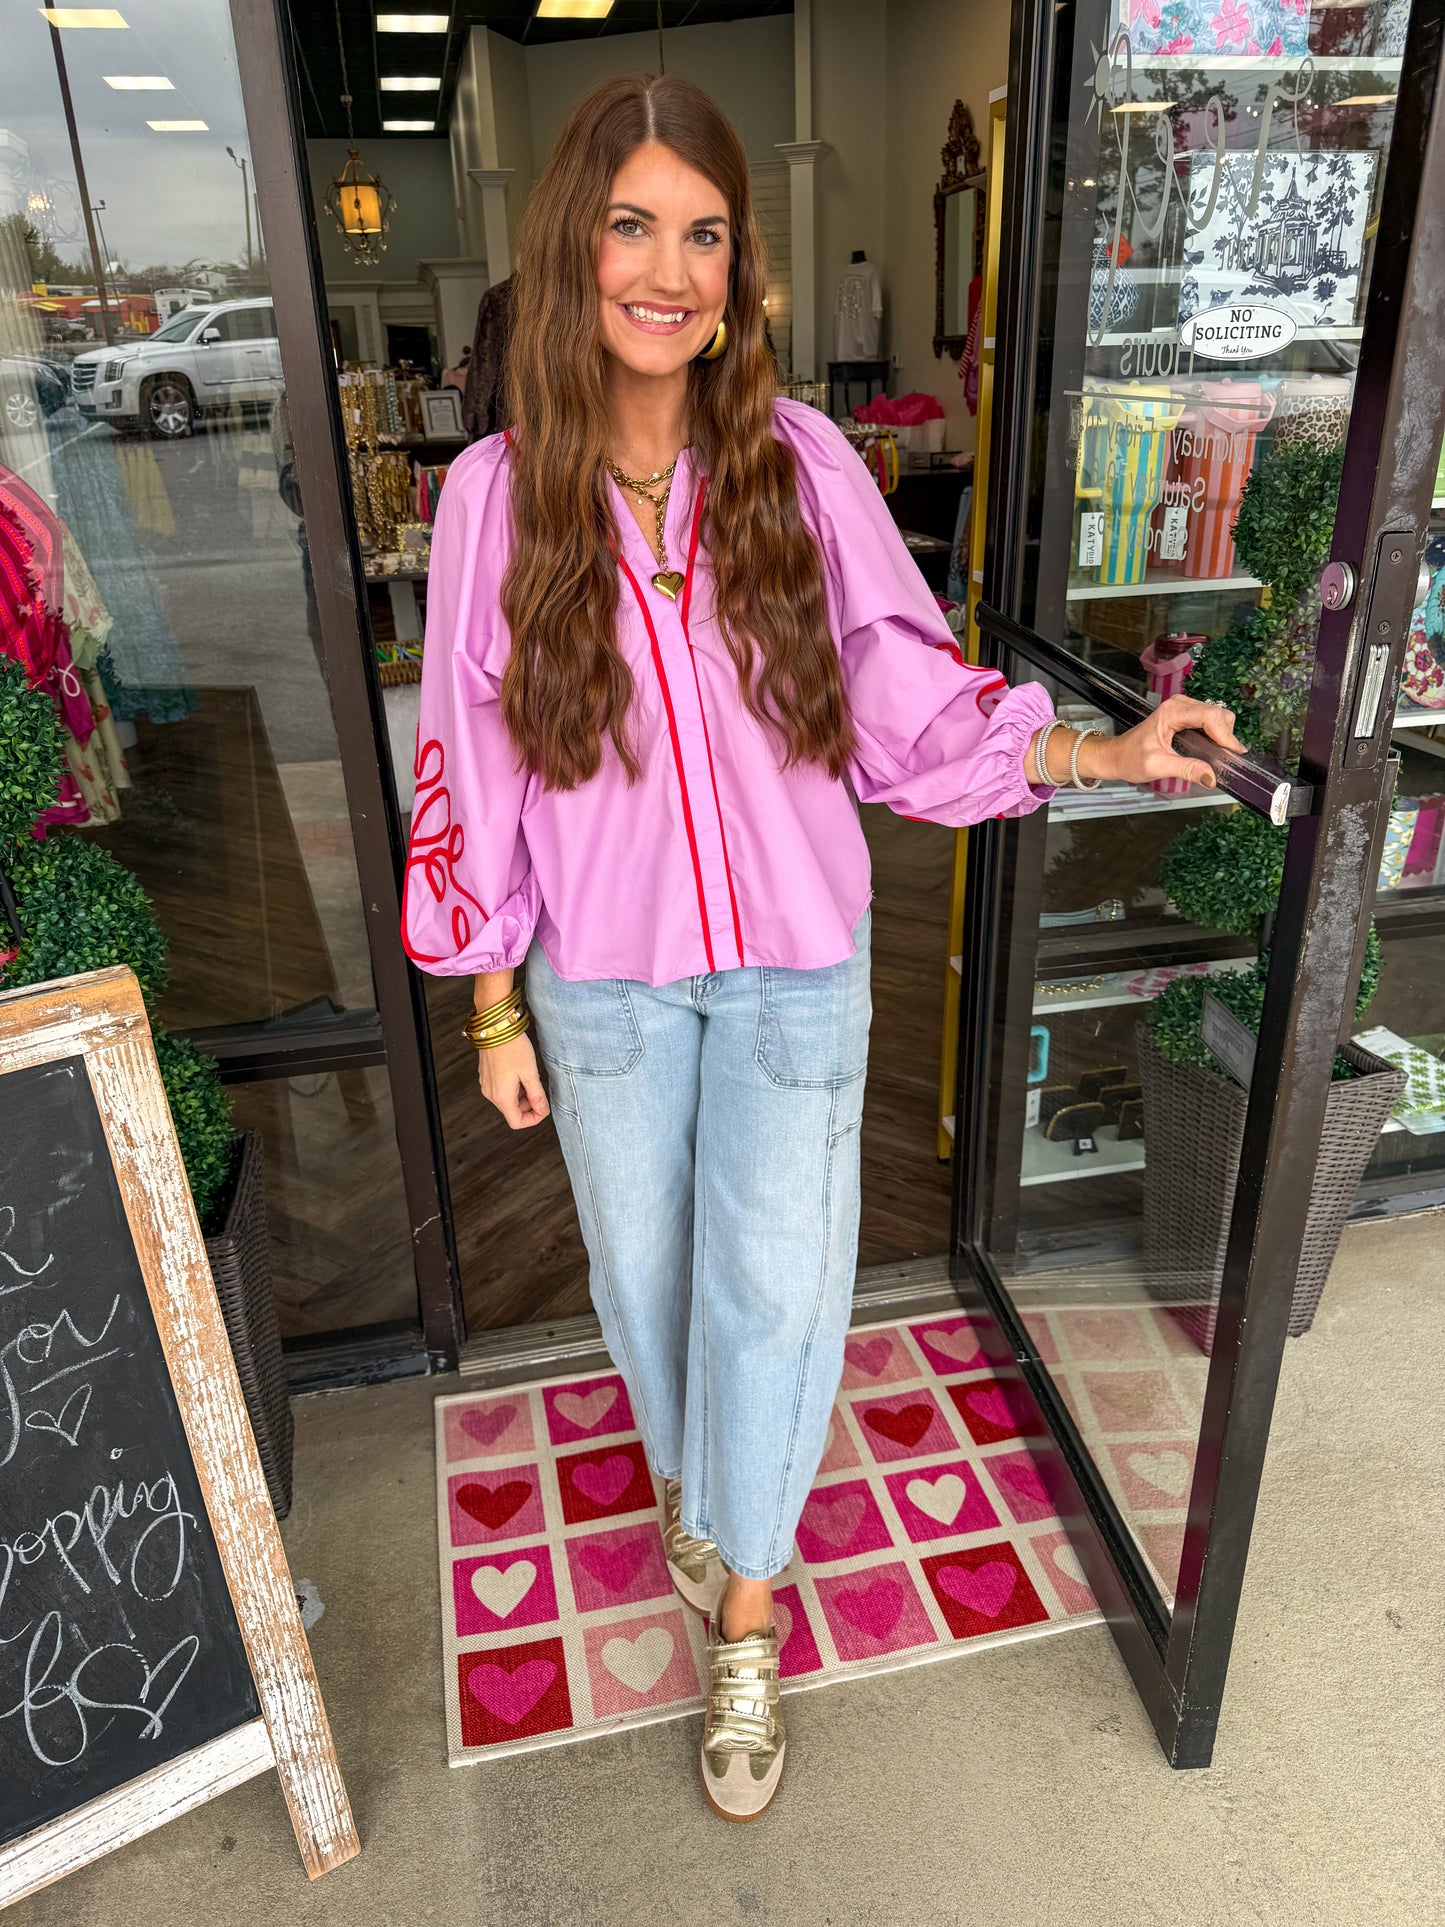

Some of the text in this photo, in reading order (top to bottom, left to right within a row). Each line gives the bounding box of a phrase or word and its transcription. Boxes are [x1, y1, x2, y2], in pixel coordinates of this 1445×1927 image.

[1229, 309, 1252, 323] NO
[1195, 325, 1282, 341] SOLICITING
[1221, 344, 1253, 355] Thank You
[1087, 524, 1096, 565] KATYDID
[0, 1447, 201, 1602] opping
